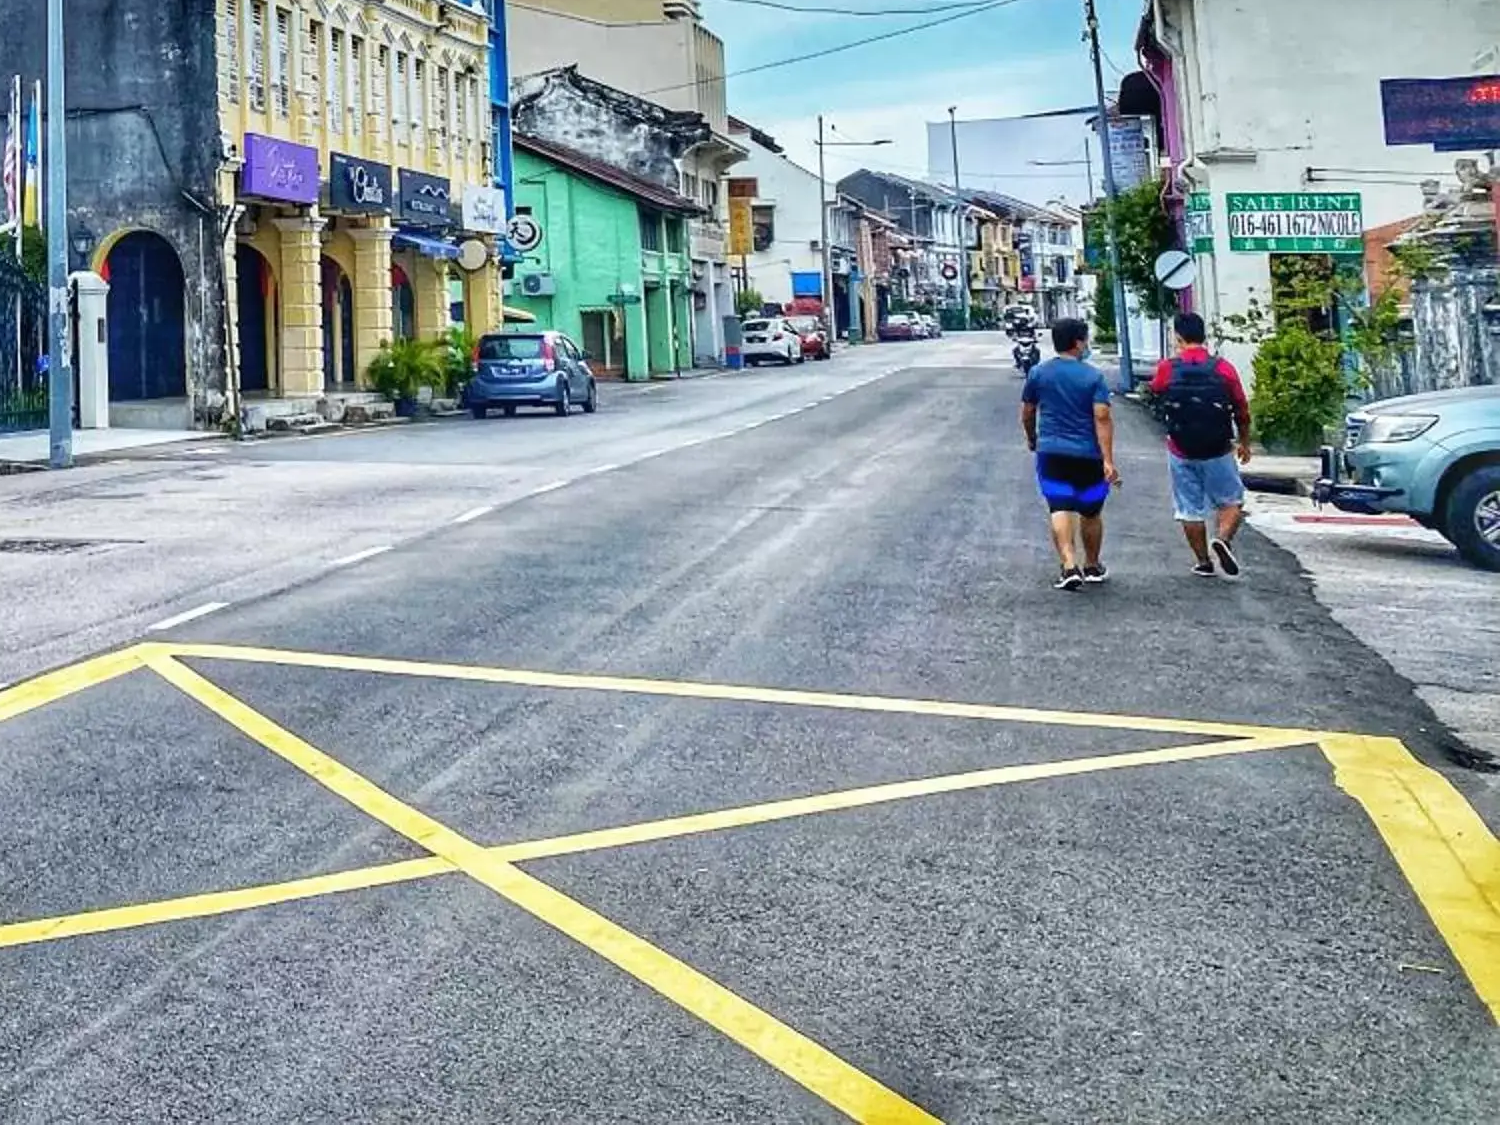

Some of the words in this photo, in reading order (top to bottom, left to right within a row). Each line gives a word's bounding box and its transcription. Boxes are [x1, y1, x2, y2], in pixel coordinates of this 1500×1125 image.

[1232, 195, 1284, 211] SALE
[1298, 195, 1359, 211] RENT
[1319, 213, 1360, 236] NICOLE
